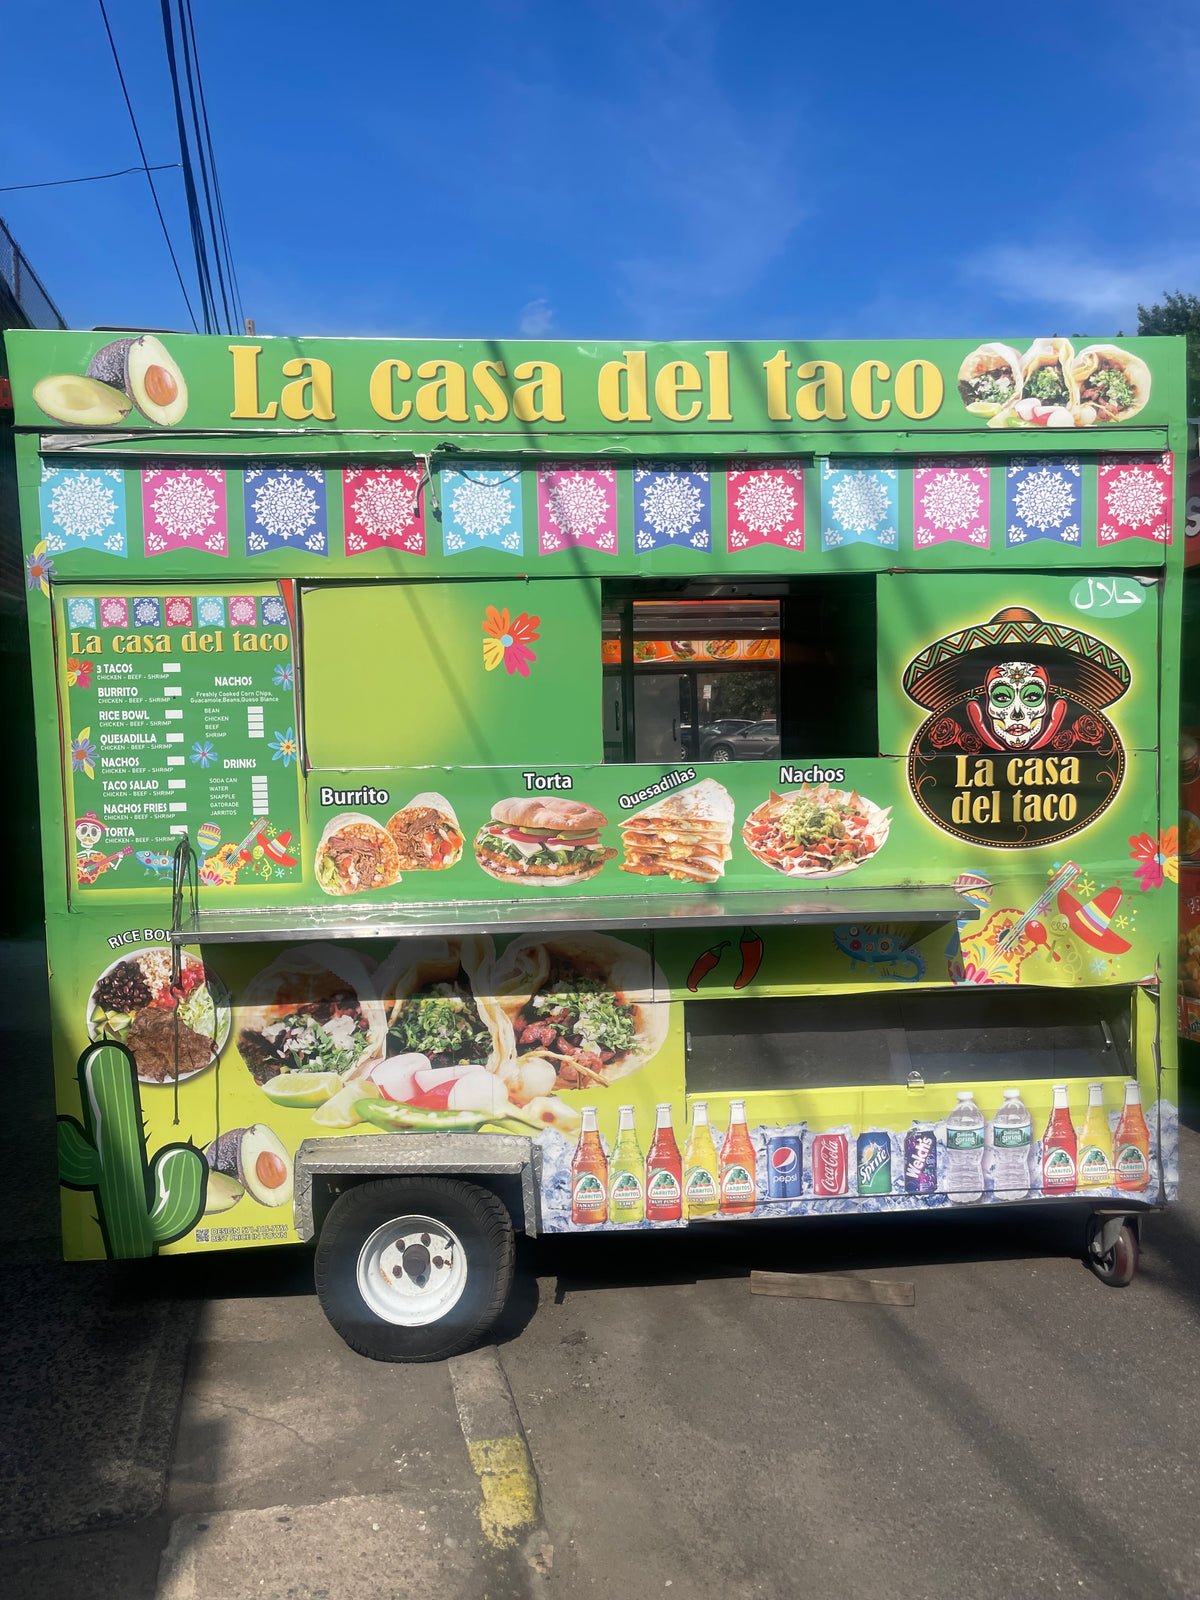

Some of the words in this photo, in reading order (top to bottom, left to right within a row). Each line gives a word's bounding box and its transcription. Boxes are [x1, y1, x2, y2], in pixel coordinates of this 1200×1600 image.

[229, 345, 336, 421] La
[370, 359, 566, 423] casa
[597, 350, 732, 422] del
[762, 349, 945, 421] taco
[1074, 578, 1142, 609] حلال
[71, 633, 102, 655] La
[112, 634, 172, 654] casa
[181, 631, 224, 653] del
[232, 630, 289, 653] taco
[96, 665, 102, 674] 3
[103, 663, 133, 674] TACOS
[214, 676, 252, 686] NACHOS
[98, 687, 138, 697] BURRITO
[99, 711, 120, 720] RICE
[122, 710, 150, 720] BOWL
[100, 733, 157, 745] QUESADILLA
[101, 757, 139, 767] NACHOS
[224, 759, 256, 768] DRINKS
[779, 765, 845, 784] Nachos
[955, 755, 994, 788] La
[1006, 755, 1080, 786] casa
[102, 781, 127, 790] TACO
[130, 780, 159, 790] SALAD
[523, 772, 573, 790] Torta
[618, 767, 696, 809] Quesadillas
[320, 786, 390, 806] Burrito
[104, 804, 141, 814] NACHOS
[144, 802, 167, 813] FRIES
[952, 790, 1000, 824] del
[1012, 790, 1077, 822] taco
[105, 827, 135, 837] TORTA
[108, 930, 141, 950] RICE
[905, 1137, 933, 1179] Welch's
[859, 1149, 887, 1184] Sprite
[772, 1174, 797, 1186] pepsi
[211, 1227, 240, 1235] DESIGN
